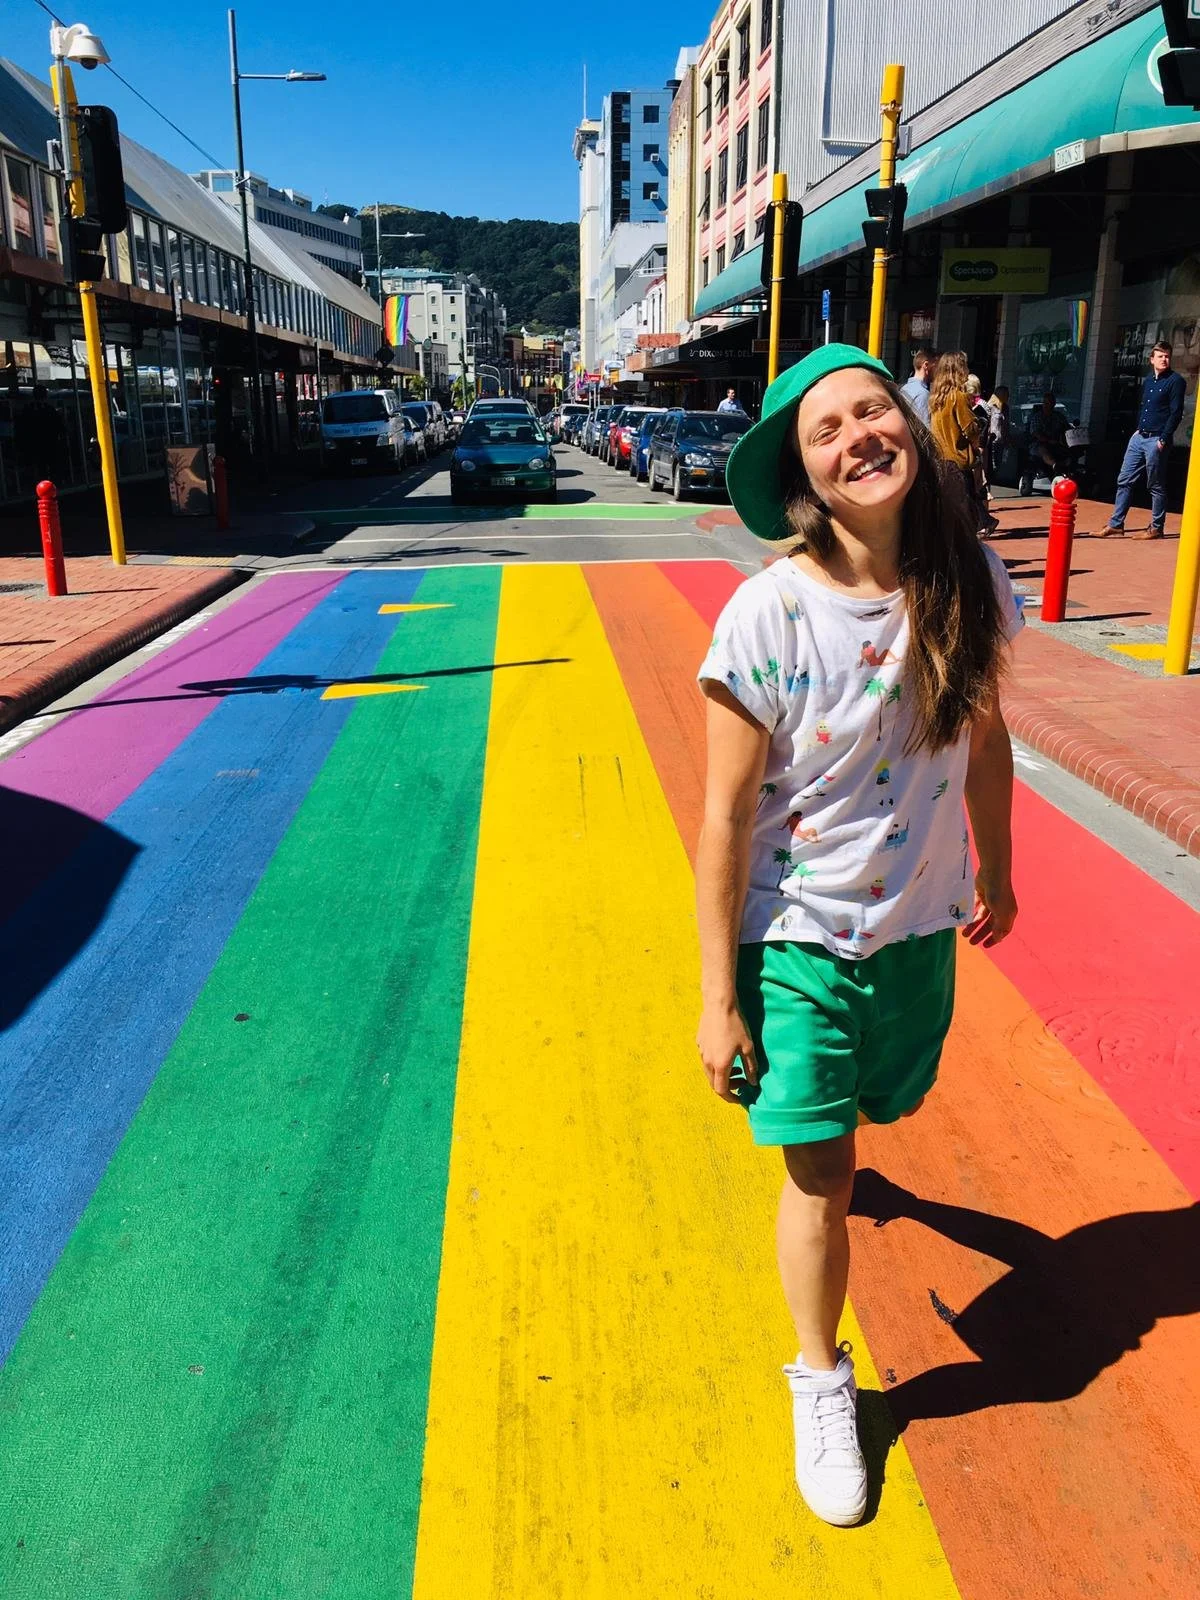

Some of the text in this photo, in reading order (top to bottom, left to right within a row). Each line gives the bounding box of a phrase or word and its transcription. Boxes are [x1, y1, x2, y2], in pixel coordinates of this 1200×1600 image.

[1057, 144, 1083, 168] DIXON ST
[954, 265, 994, 276] Specsavers
